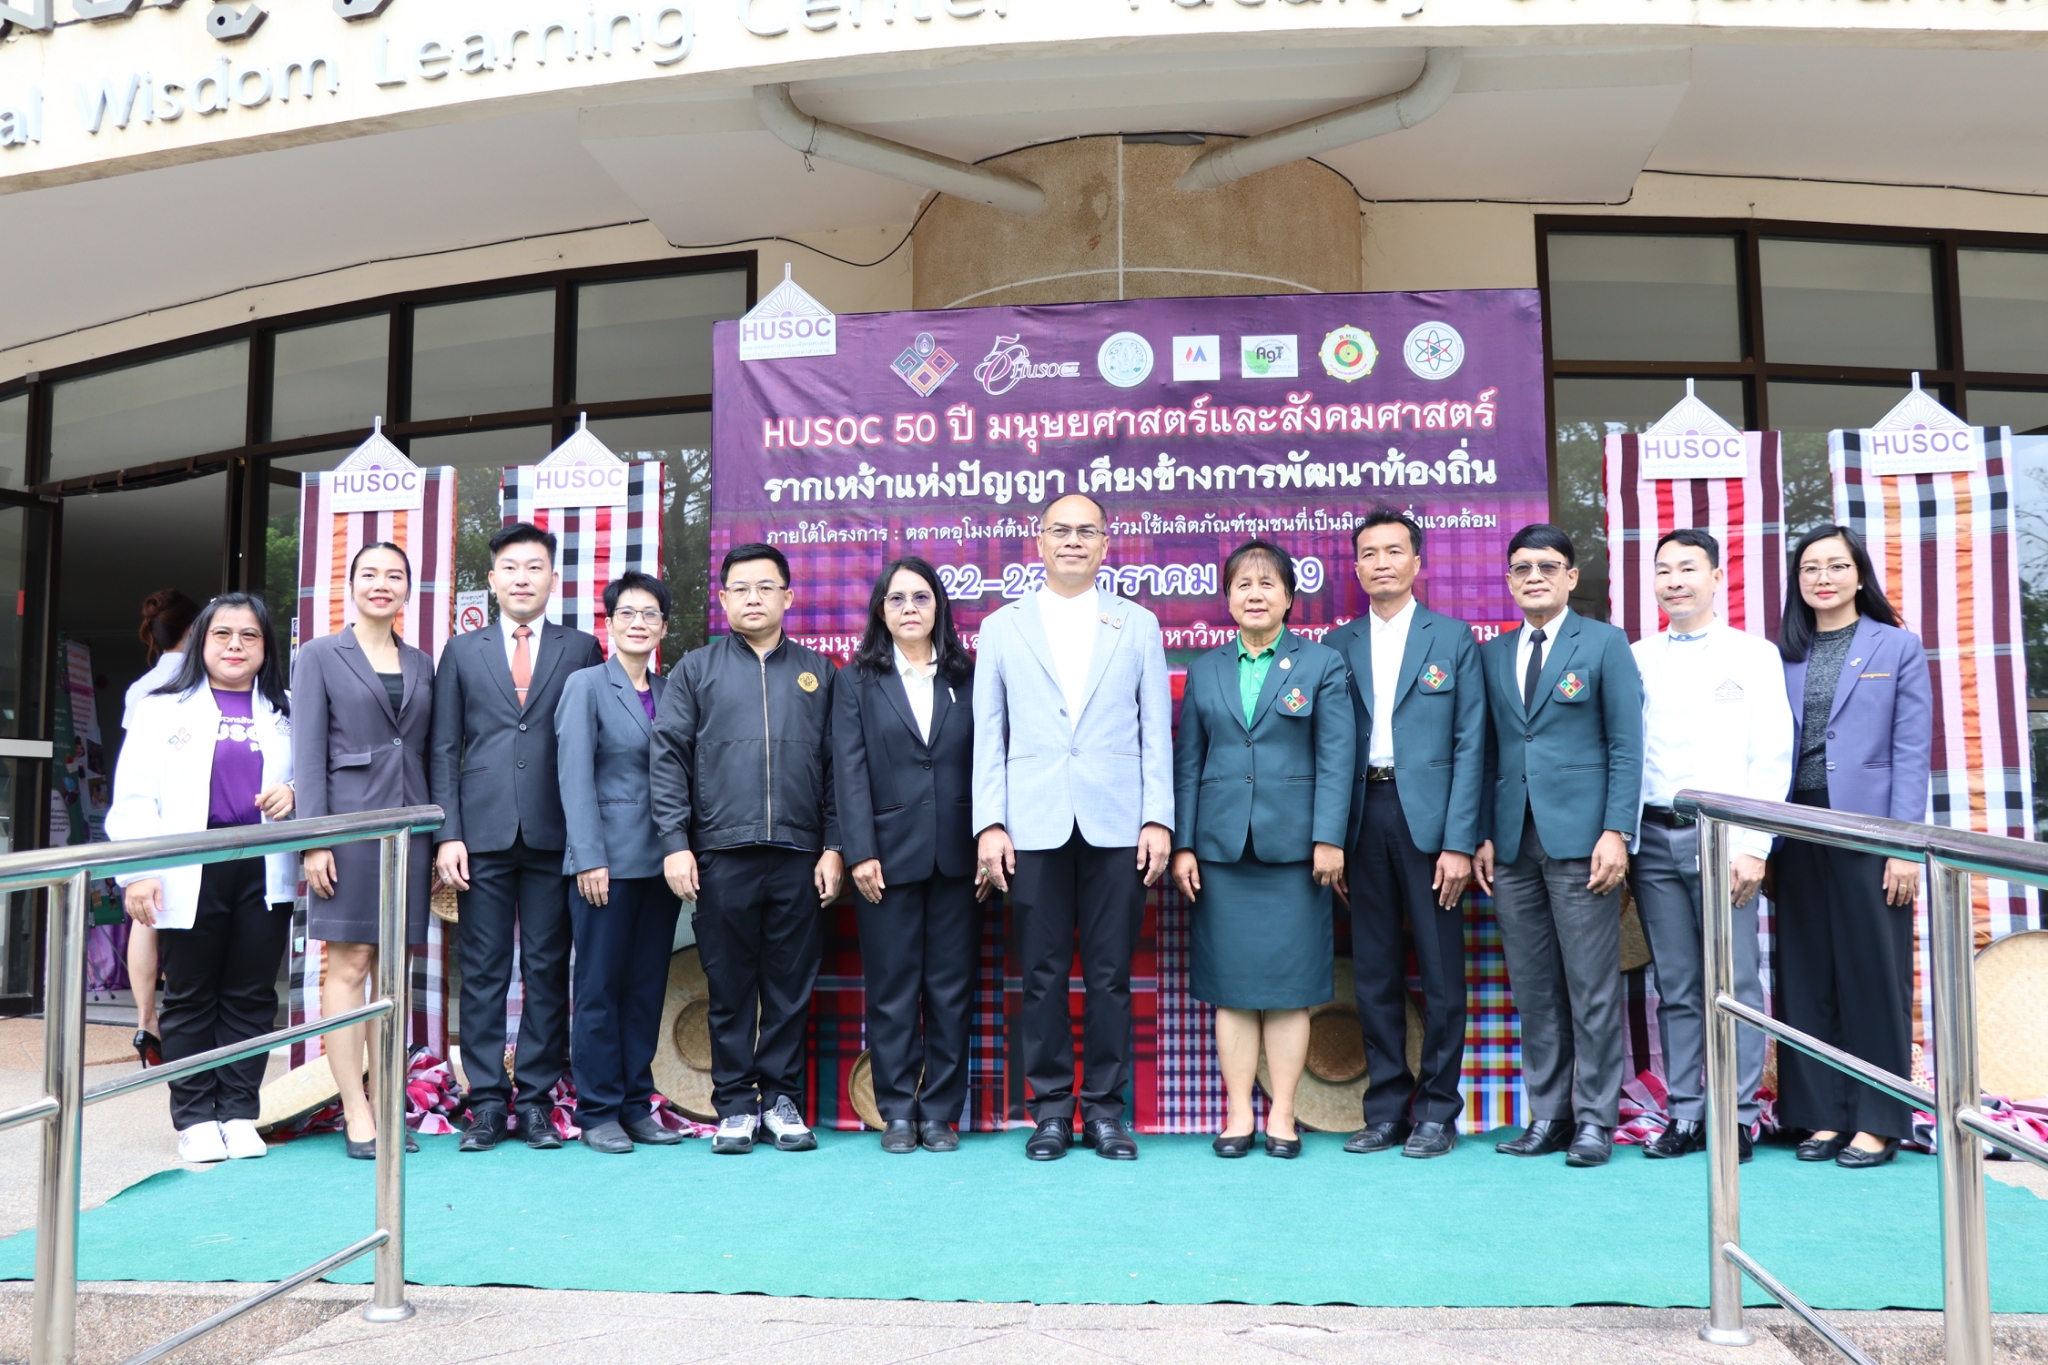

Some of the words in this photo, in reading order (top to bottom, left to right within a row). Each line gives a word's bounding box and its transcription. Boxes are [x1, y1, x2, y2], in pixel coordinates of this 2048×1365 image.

[72, 53, 340, 136] Wisdom
[374, 3, 697, 88] Learning
[742, 317, 832, 342] HUSOC
[763, 416, 882, 447] HUSOC
[895, 413, 937, 443] 50
[947, 404, 974, 441] ปี
[988, 388, 1497, 453] มนุษยศาสตร์และสังคมศาสตร์
[1644, 438, 1740, 459] HUSOC
[1872, 431, 1969, 455] HUSOC
[333, 471, 416, 494] HUSOC
[536, 467, 623, 490] HUSOC
[764, 459, 1066, 504] รากเหง้าแห่งปัญญา
[1078, 438, 1497, 494] เคียงข้างการพัฒนาท้องถิ่น
[766, 520, 888, 545] ภายใต้โครงการ
